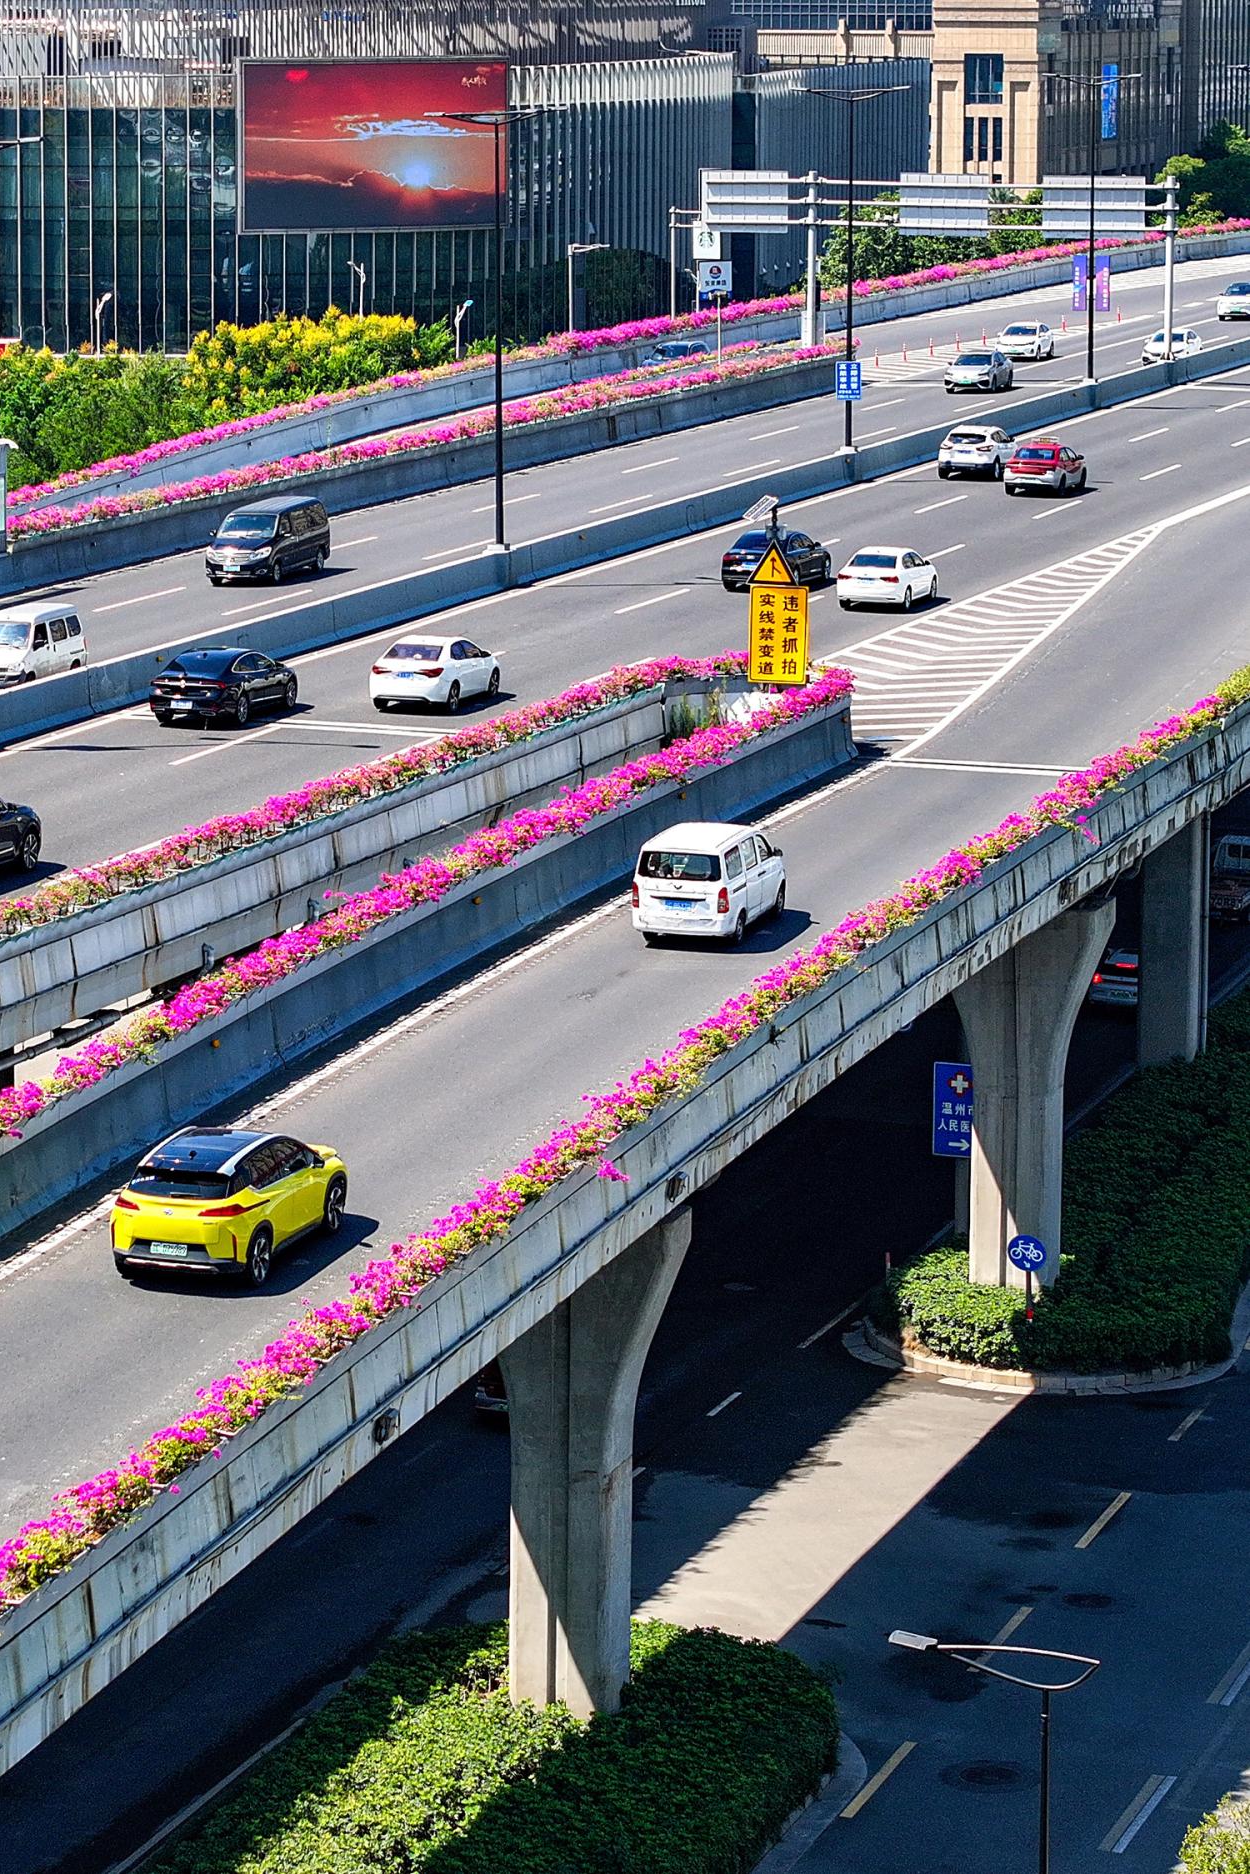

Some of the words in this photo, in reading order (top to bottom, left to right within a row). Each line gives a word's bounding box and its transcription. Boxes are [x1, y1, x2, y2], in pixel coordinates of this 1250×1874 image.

[758, 593, 775, 675] 实线禁变道
[782, 595, 799, 675] 违者抓拍
[937, 1118, 970, 1132] 人民医
